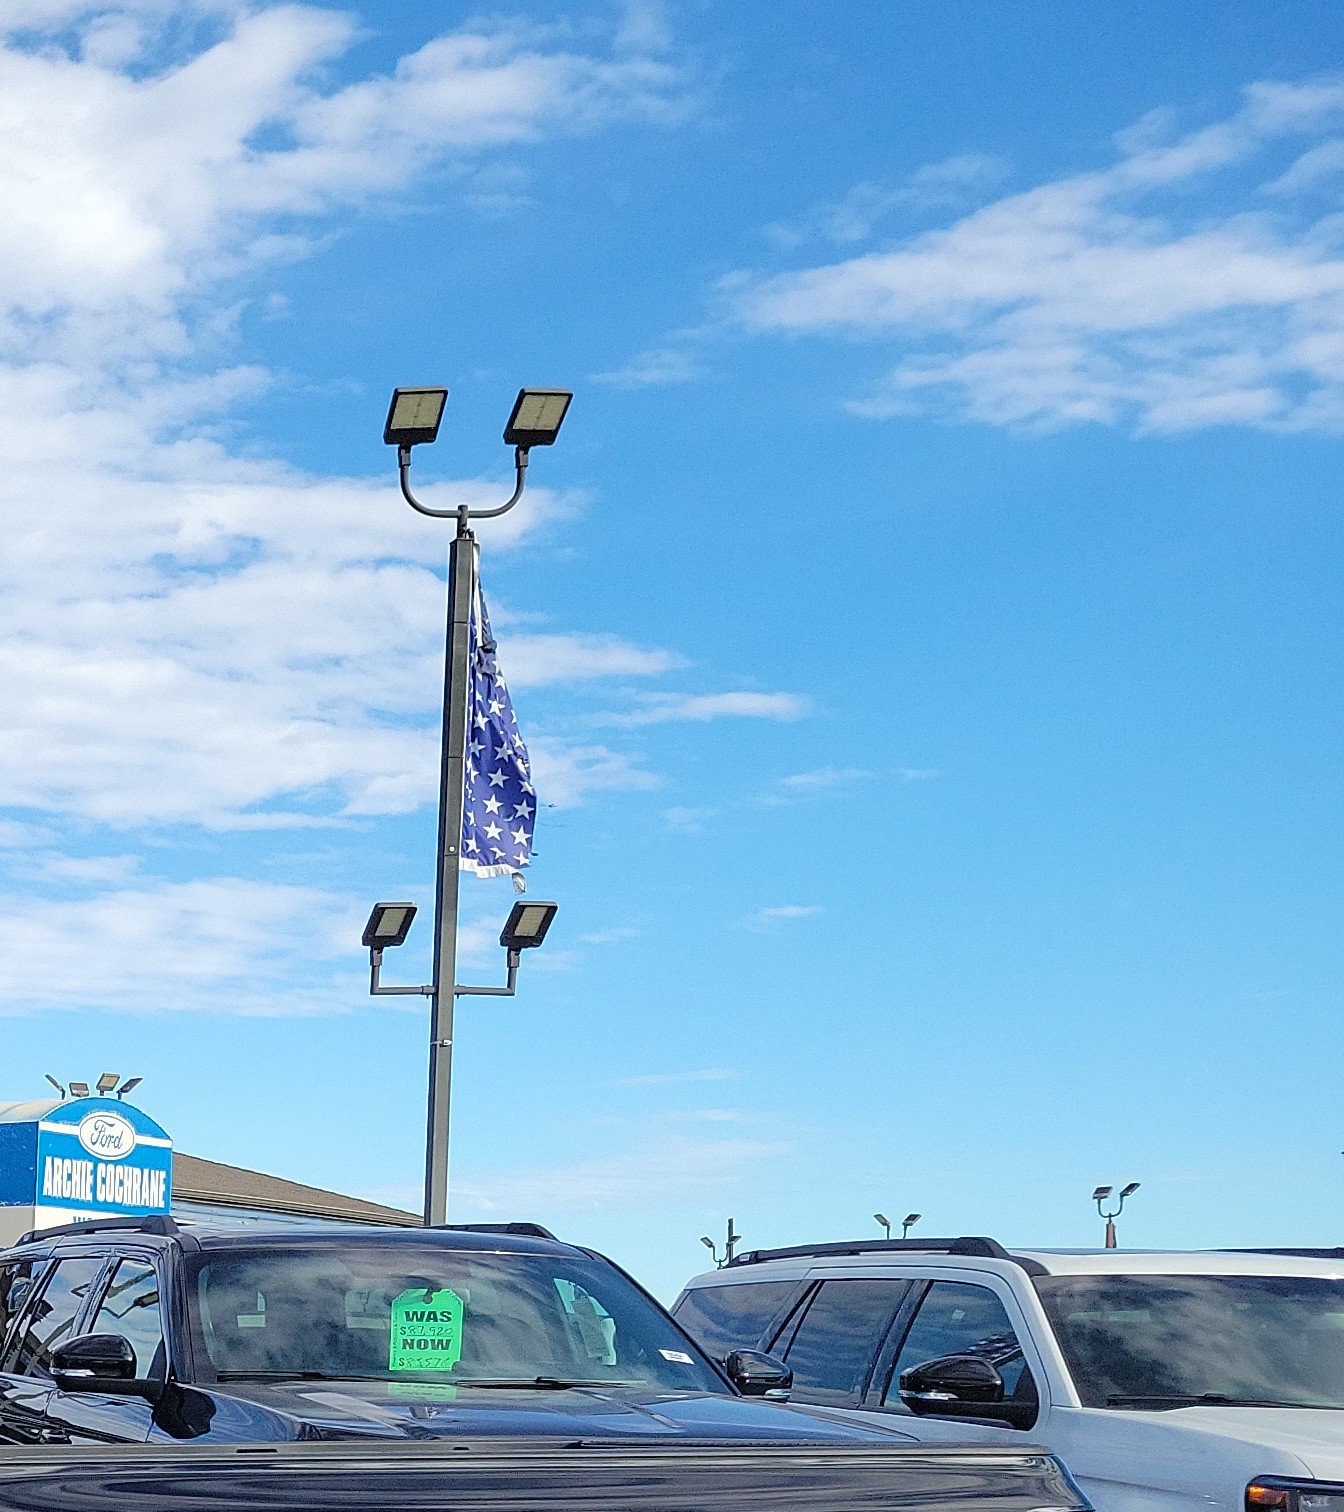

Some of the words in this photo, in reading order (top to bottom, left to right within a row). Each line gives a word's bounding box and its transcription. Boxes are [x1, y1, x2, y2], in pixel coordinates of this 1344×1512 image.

[90, 1120, 124, 1149] Ford
[43, 1156, 94, 1202] ARCHIE
[96, 1163, 166, 1208] COCHRANE
[404, 1310, 452, 1322] WAS
[402, 1339, 451, 1350] NOW
